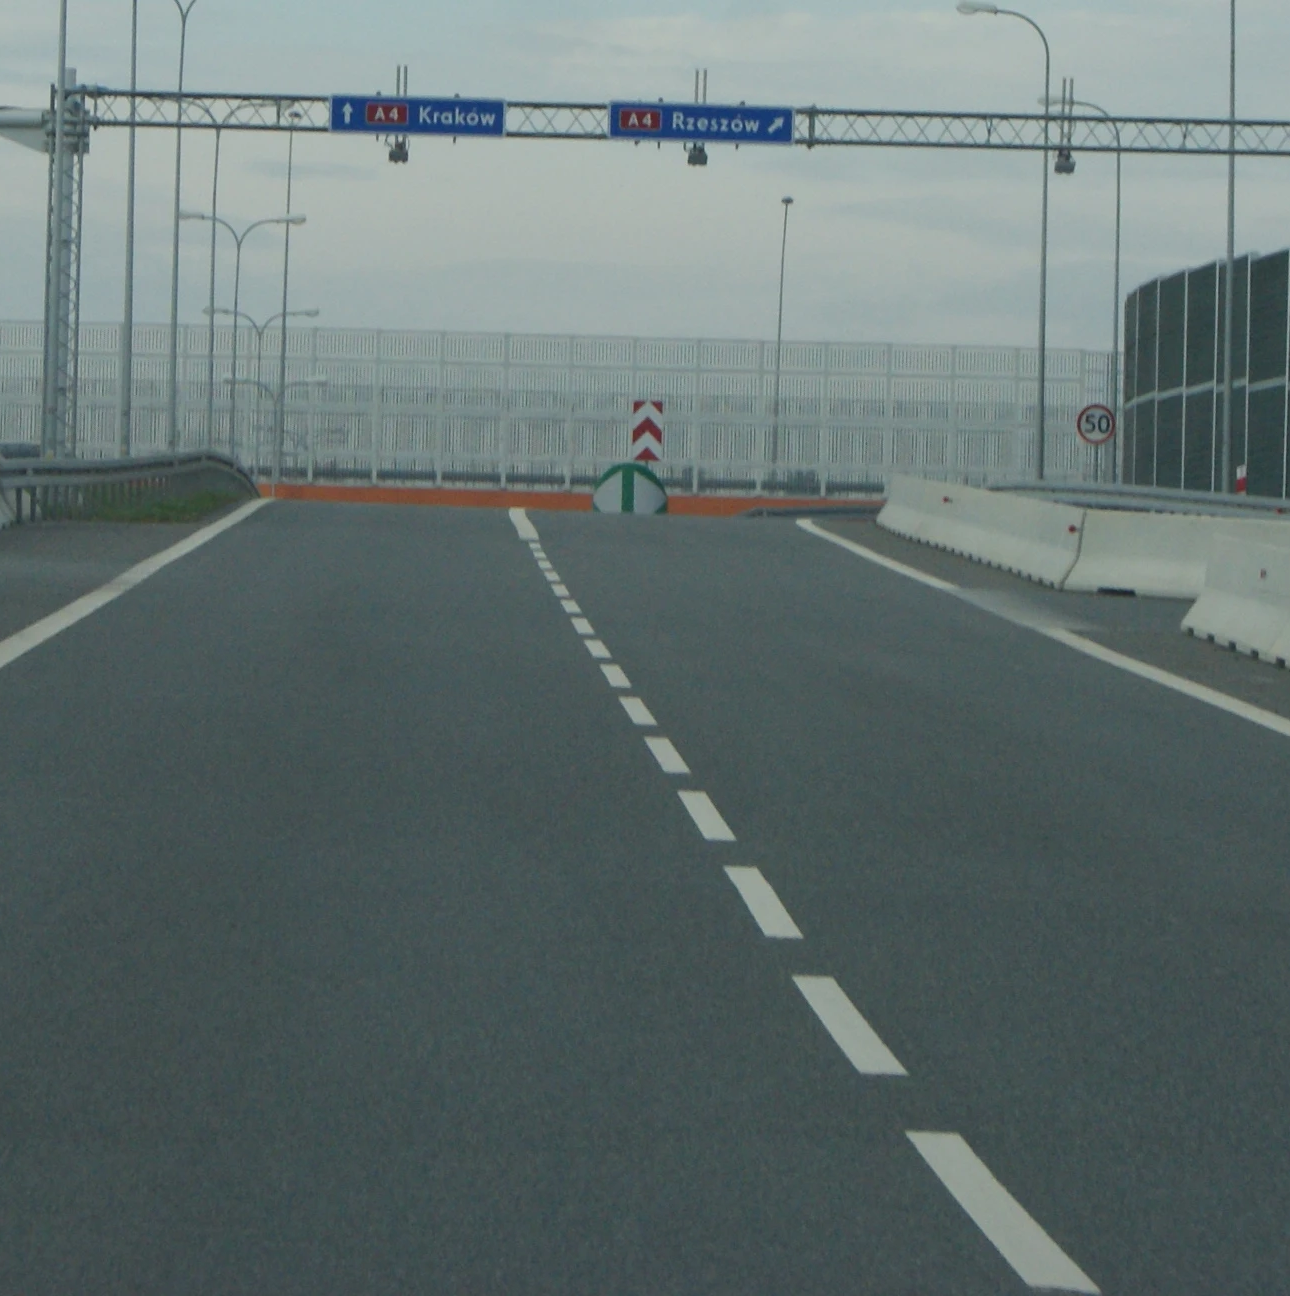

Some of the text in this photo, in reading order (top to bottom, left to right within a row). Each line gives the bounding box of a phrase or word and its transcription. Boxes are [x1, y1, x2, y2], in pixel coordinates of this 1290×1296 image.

[374, 106, 496, 127] A4 Kraków
[628, 112, 760, 134] A4 Rzeszów
[1084, 413, 1111, 434] 50
